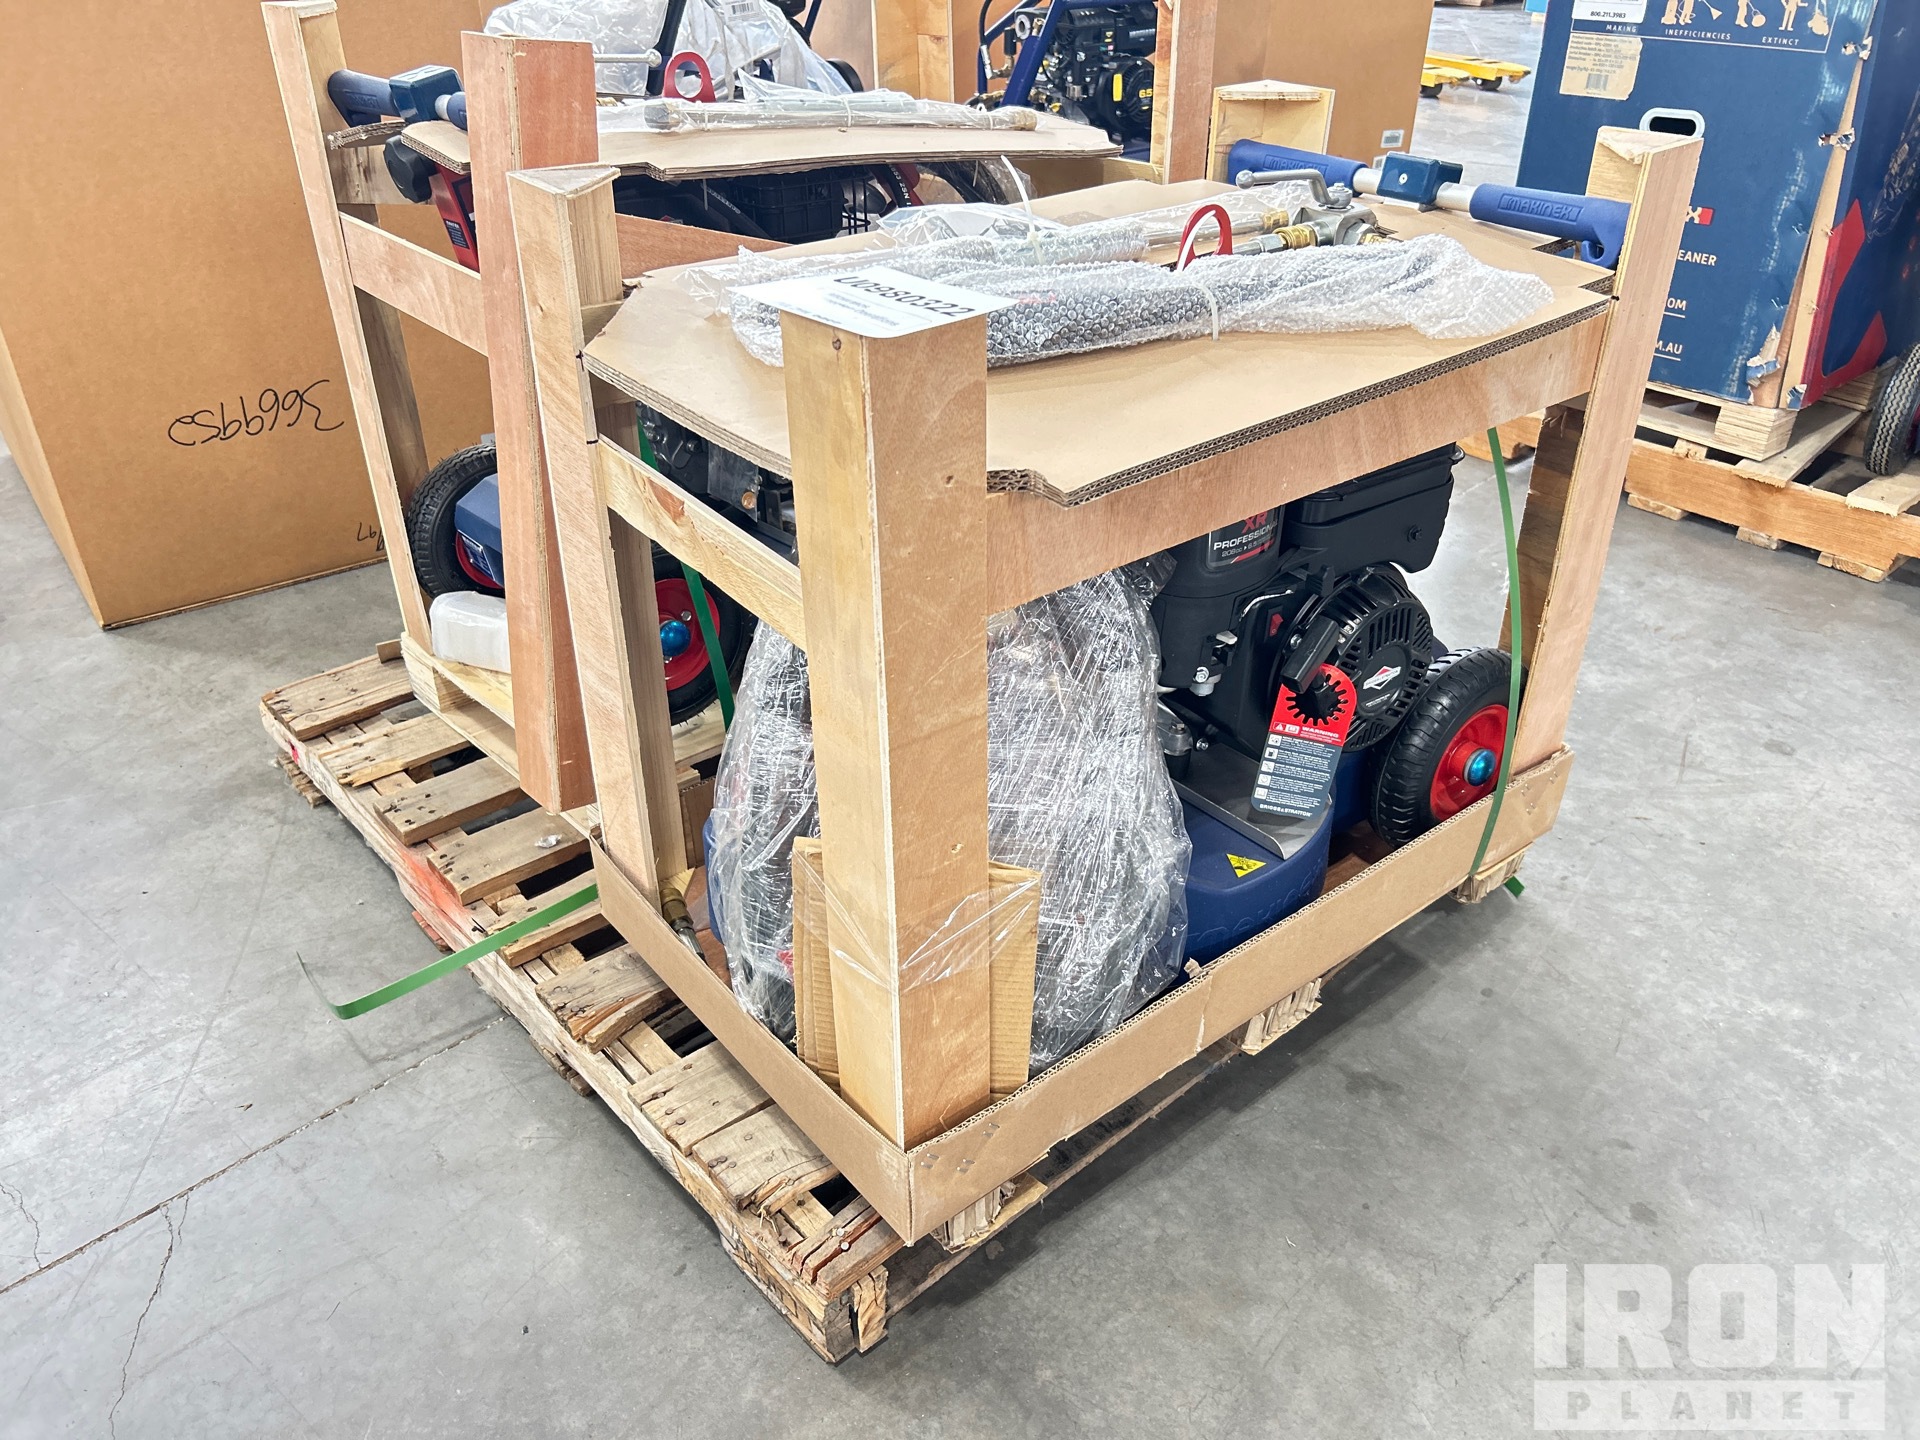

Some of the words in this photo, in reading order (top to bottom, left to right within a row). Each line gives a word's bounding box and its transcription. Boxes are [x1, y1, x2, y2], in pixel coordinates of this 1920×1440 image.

[1605, 23, 1637, 33] MAKING
[1665, 28, 1731, 40] INEFFICIENCIES
[1762, 36, 1800, 46] EXTINCT
[1507, 196, 1573, 220] MAKINEX
[833, 275, 976, 317] U0980322
[1666, 298, 1687, 311] OM
[168, 379, 345, 446] 3669952
[1301, 726, 1340, 738] WARNING
